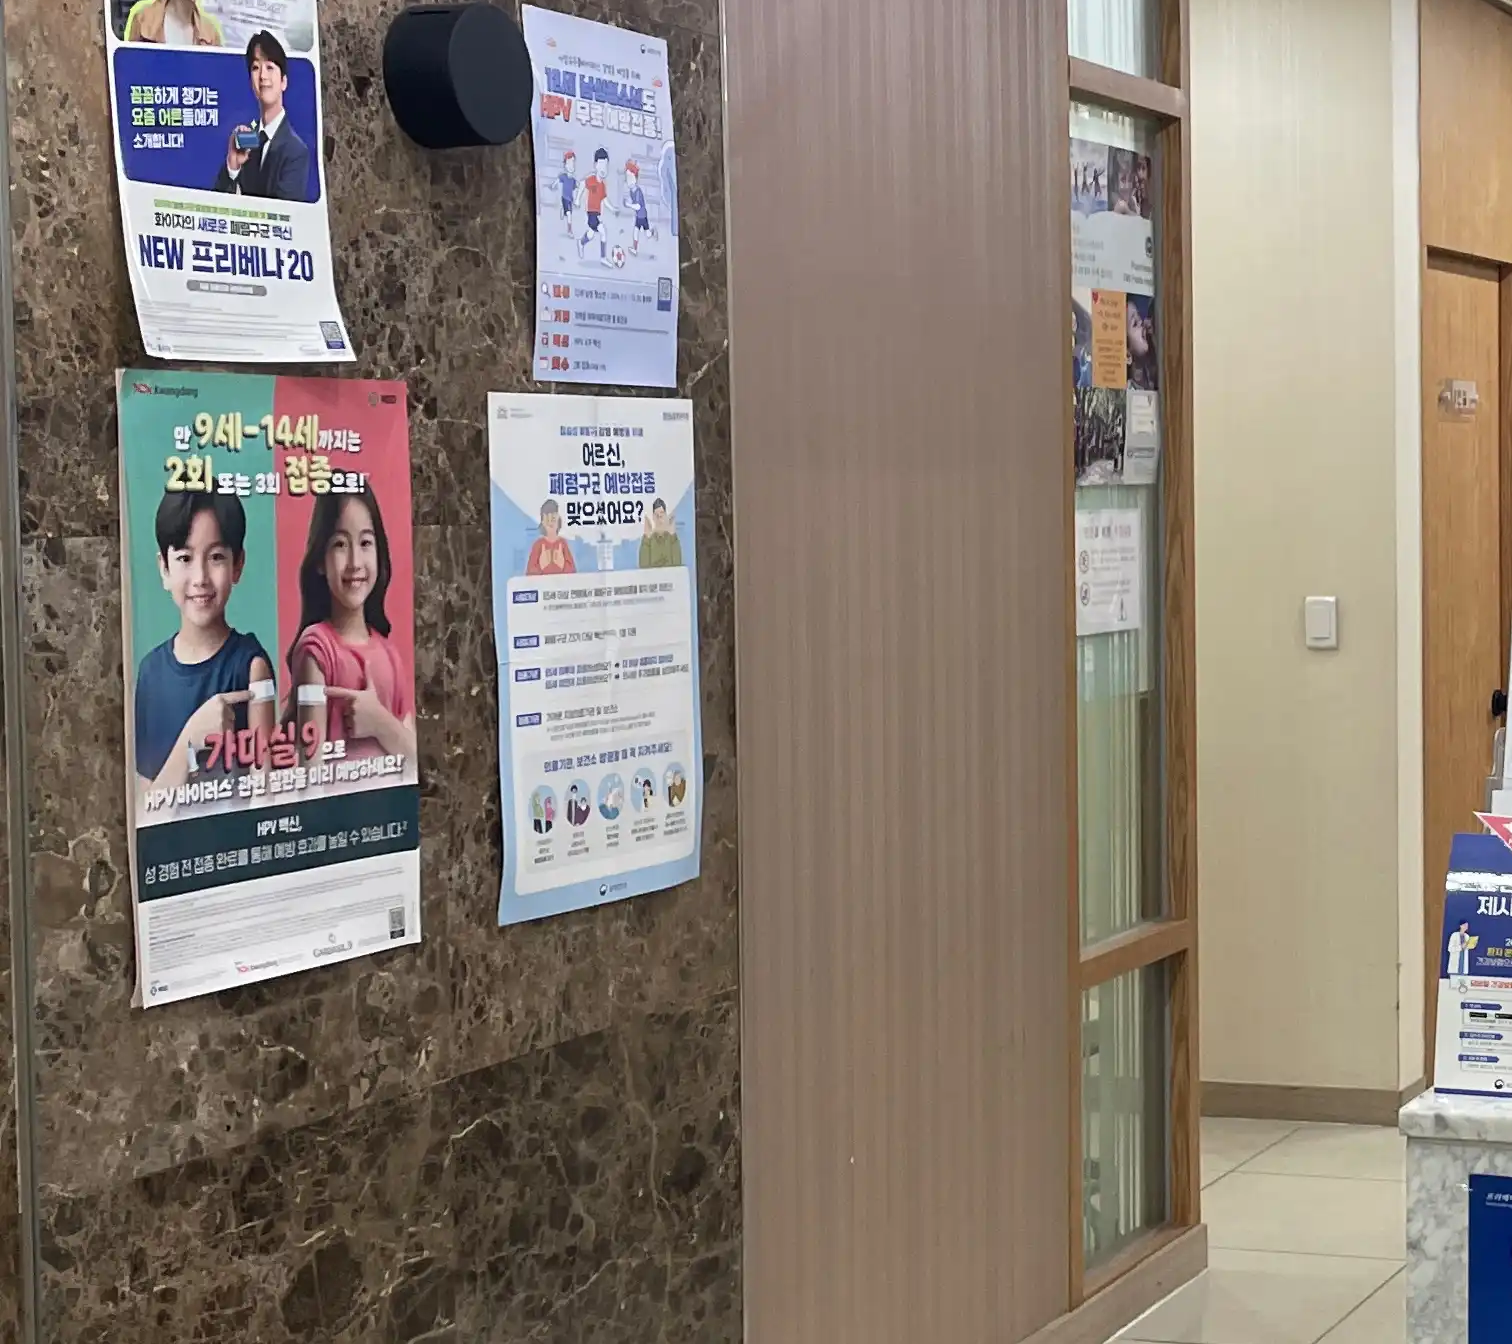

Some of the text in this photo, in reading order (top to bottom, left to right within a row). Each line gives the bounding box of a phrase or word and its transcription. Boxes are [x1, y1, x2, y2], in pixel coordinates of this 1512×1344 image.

[130, 85, 218, 105] 꼼꼼하게 챙기는
[132, 107, 218, 126] 요즘 어른들에게
[576, 99, 605, 128] 무료
[154, 211, 195, 231] 화이자의
[198, 217, 228, 234] 새로운
[272, 225, 293, 241] 백신
[138, 234, 184, 270] NEW
[582, 443, 626, 467] 어르신,
[165, 455, 213, 494] 2회
[216, 471, 252, 496] 또는
[255, 472, 281, 495] 3회
[549, 471, 656, 496] 폐렴구균 예방접종
[567, 500, 644, 527] 맞으셨어요?
[238, 773, 268, 798] 관련
[269, 767, 308, 794] 질환을
[309, 762, 335, 784] 미리
[257, 821, 277, 837] HPV
